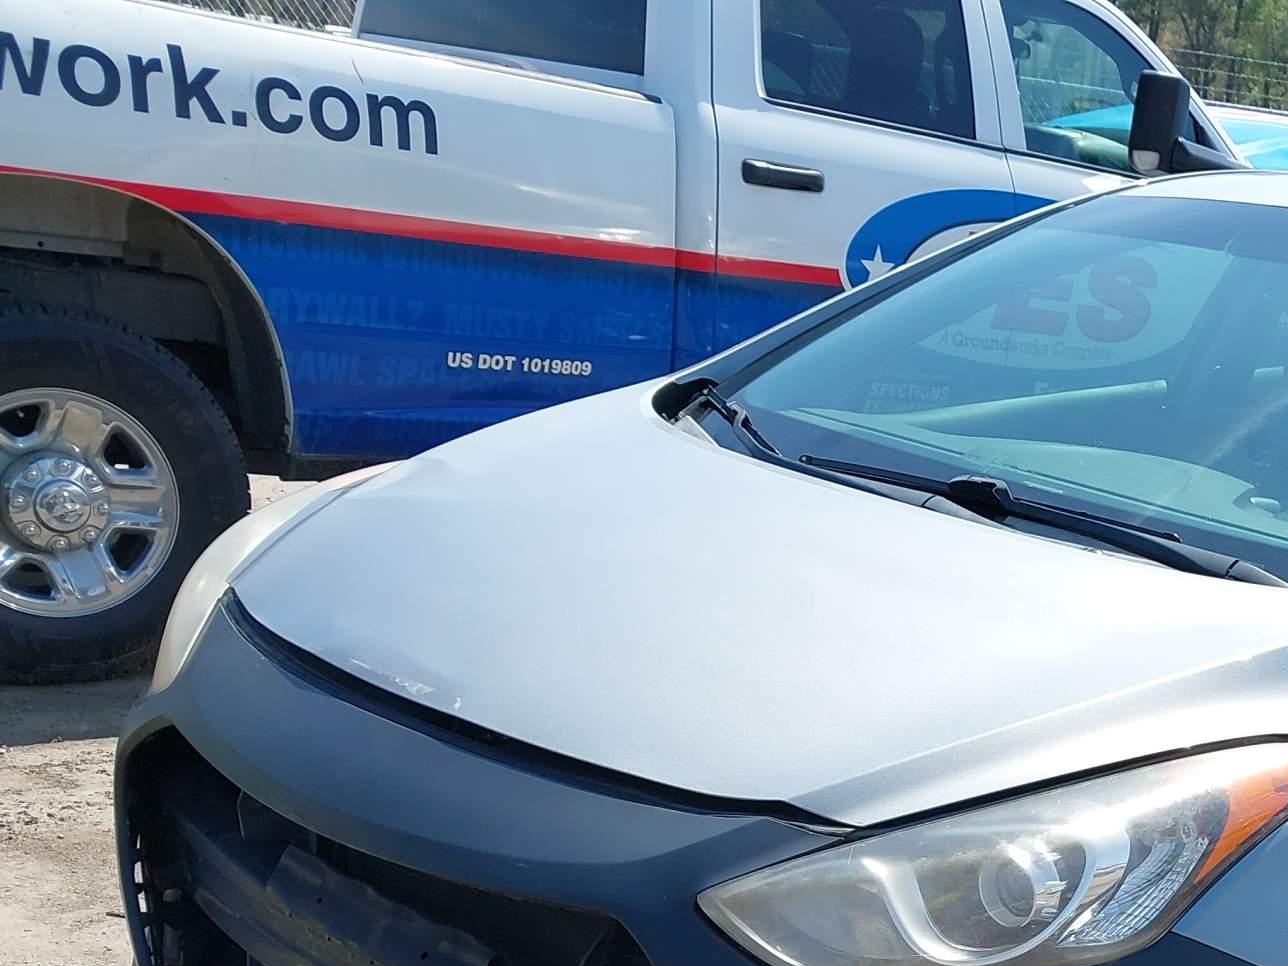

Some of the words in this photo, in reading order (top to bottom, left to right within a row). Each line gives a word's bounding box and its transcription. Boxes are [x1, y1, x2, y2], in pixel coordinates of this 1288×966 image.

[0, 31, 438, 156] work.com
[262, 287, 425, 331] RYWALL?
[990, 254, 1157, 342] ES
[447, 351, 474, 369] US
[477, 354, 517, 373] DOT
[521, 356, 593, 377] 1019809
